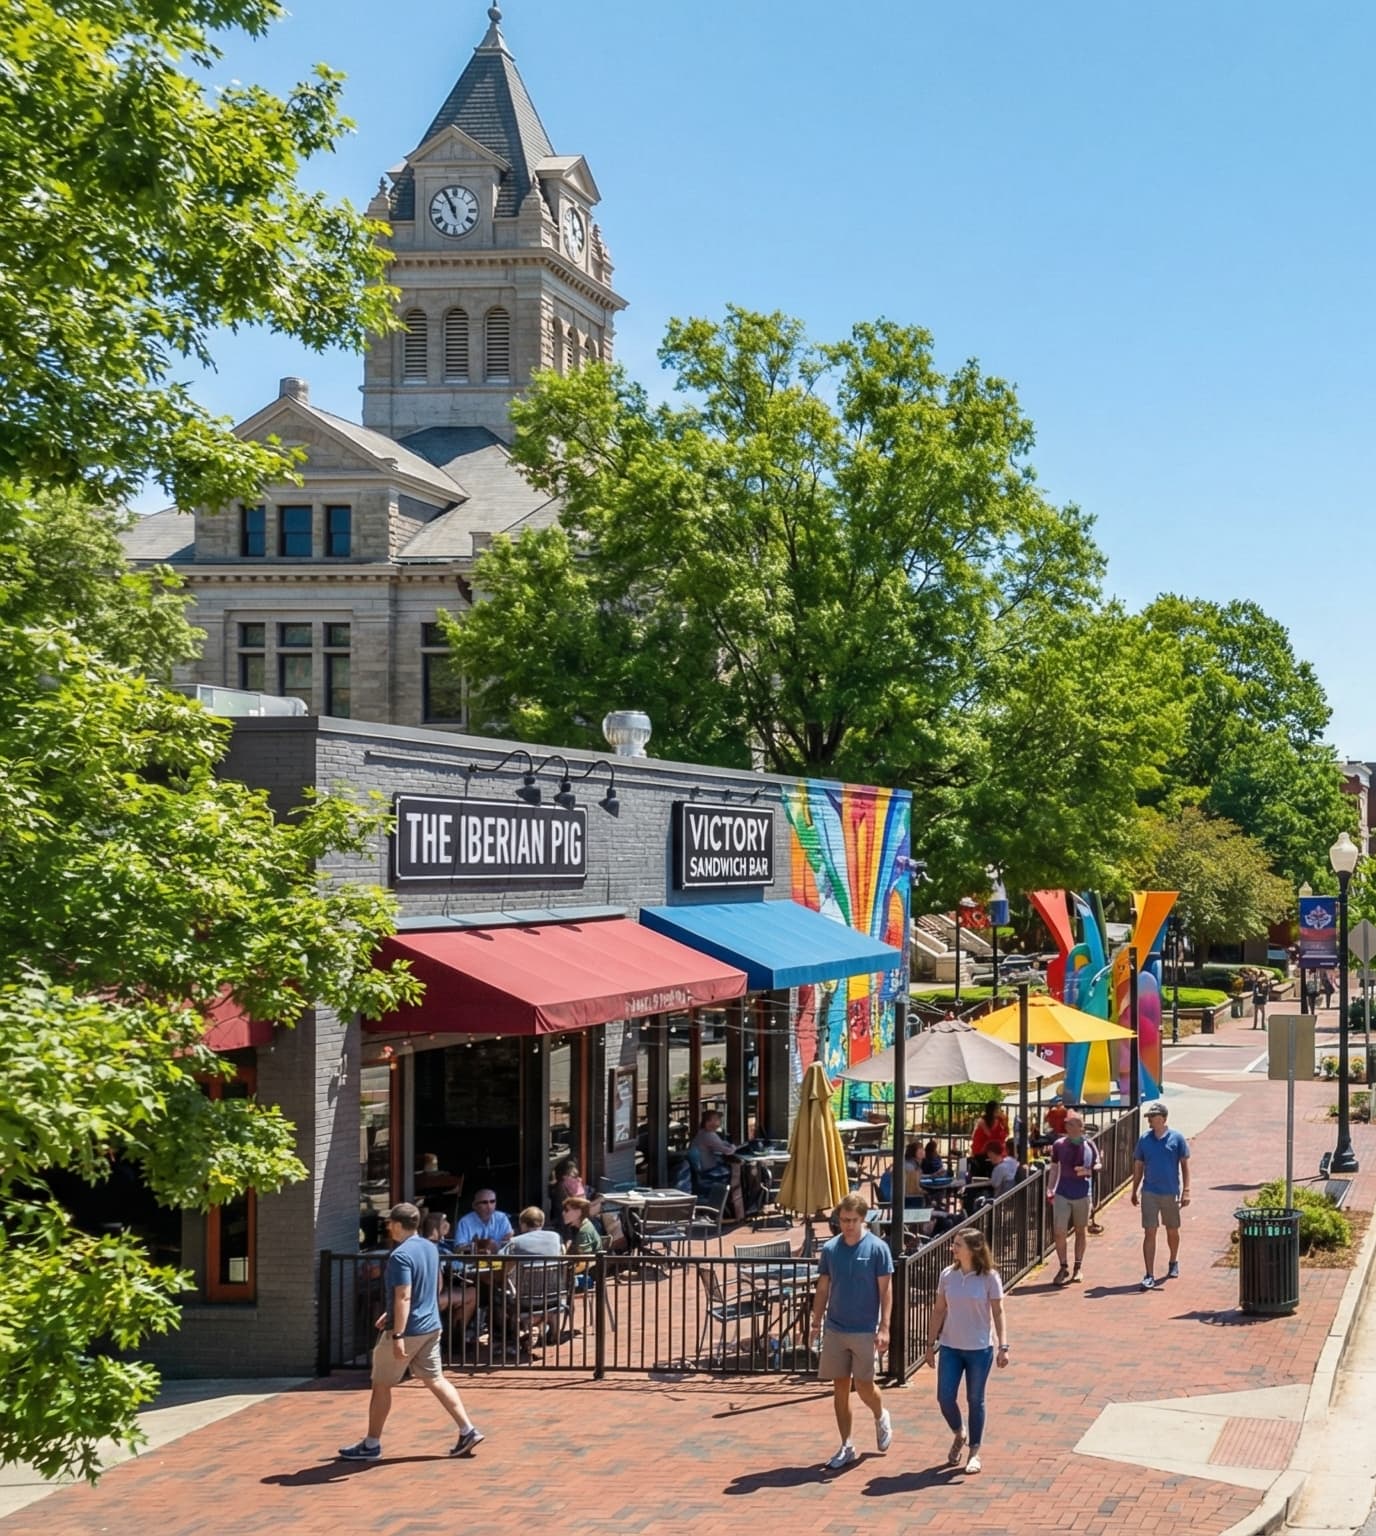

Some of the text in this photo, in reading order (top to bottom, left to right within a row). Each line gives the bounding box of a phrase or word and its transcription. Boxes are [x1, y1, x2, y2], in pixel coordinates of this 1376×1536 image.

[406, 812, 582, 866] THE IBERIAN PIG
[689, 814, 769, 851] VICTORY
[690, 856, 769, 877] SANDWICH BAR
